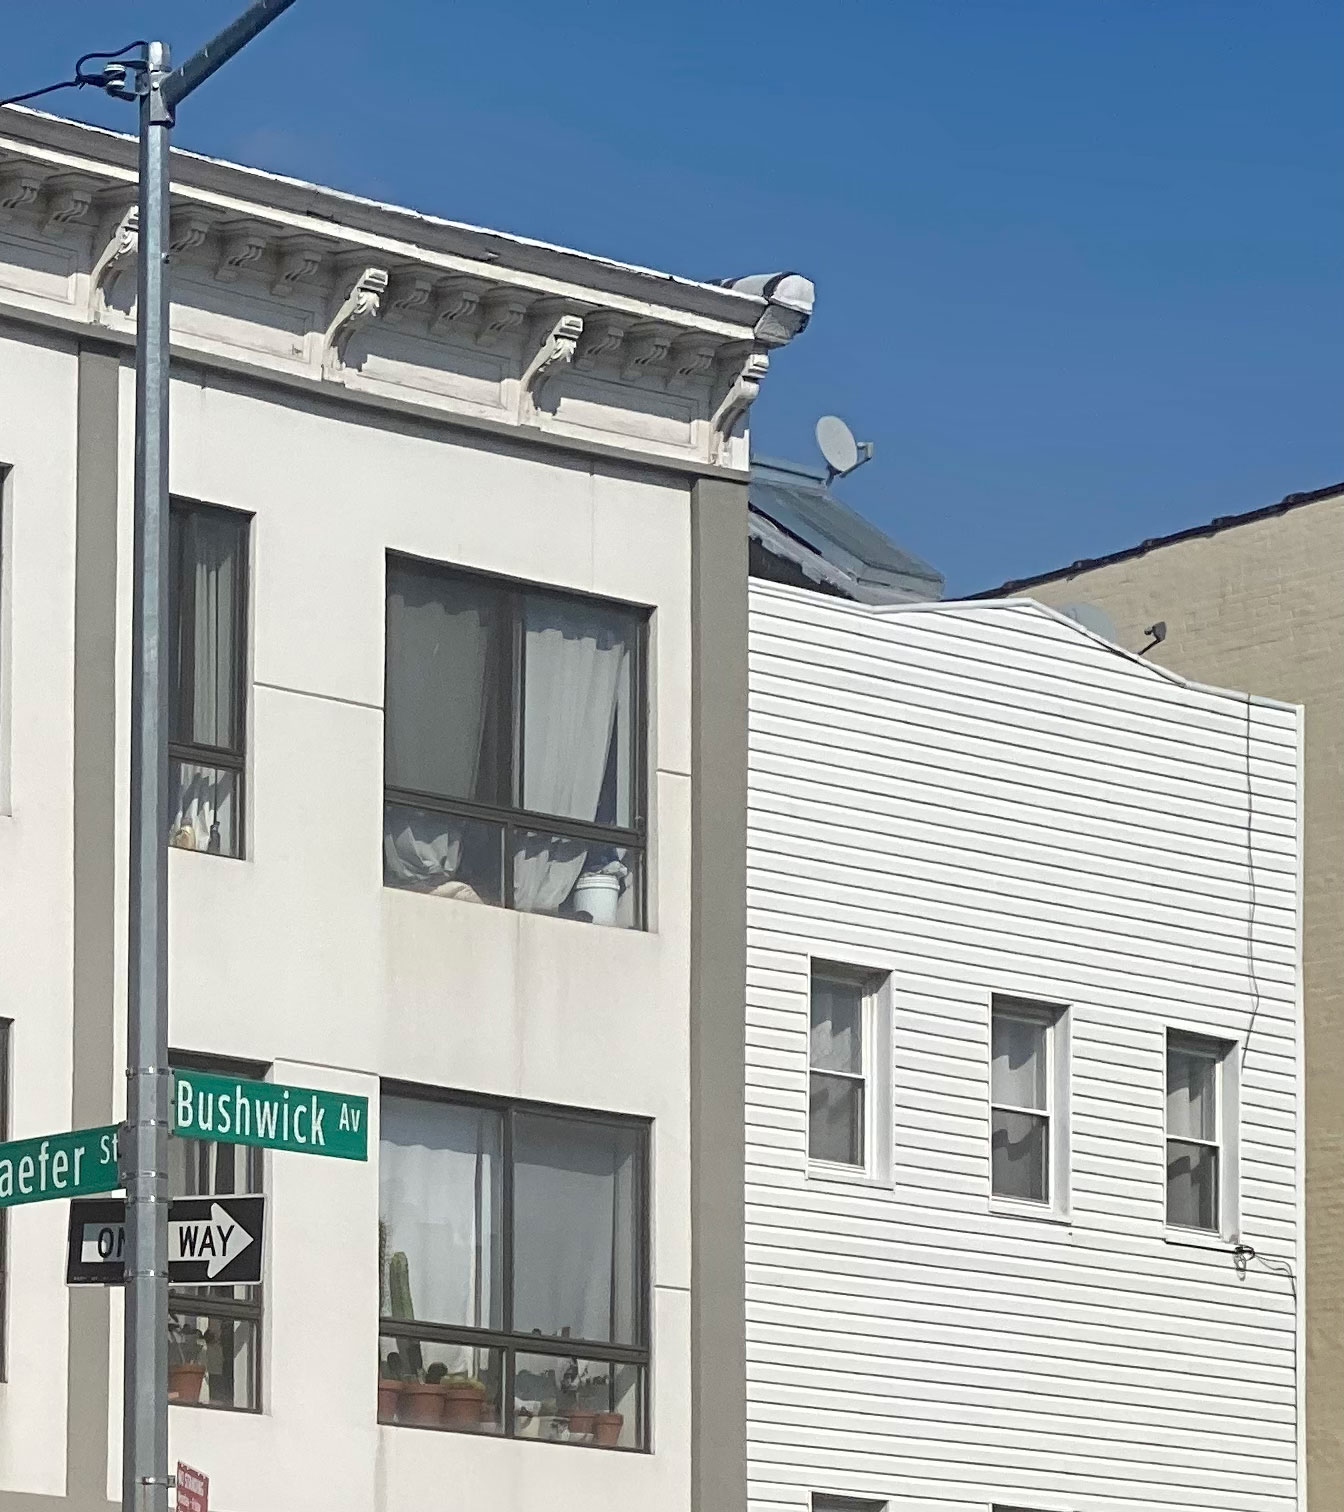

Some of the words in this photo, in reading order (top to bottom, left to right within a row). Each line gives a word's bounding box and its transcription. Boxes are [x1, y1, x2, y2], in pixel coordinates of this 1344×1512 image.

[176, 1080, 326, 1146] Bushwick
[338, 1102, 362, 1133] Av
[100, 1132, 118, 1165] St
[178, 1224, 235, 1258] WAY
